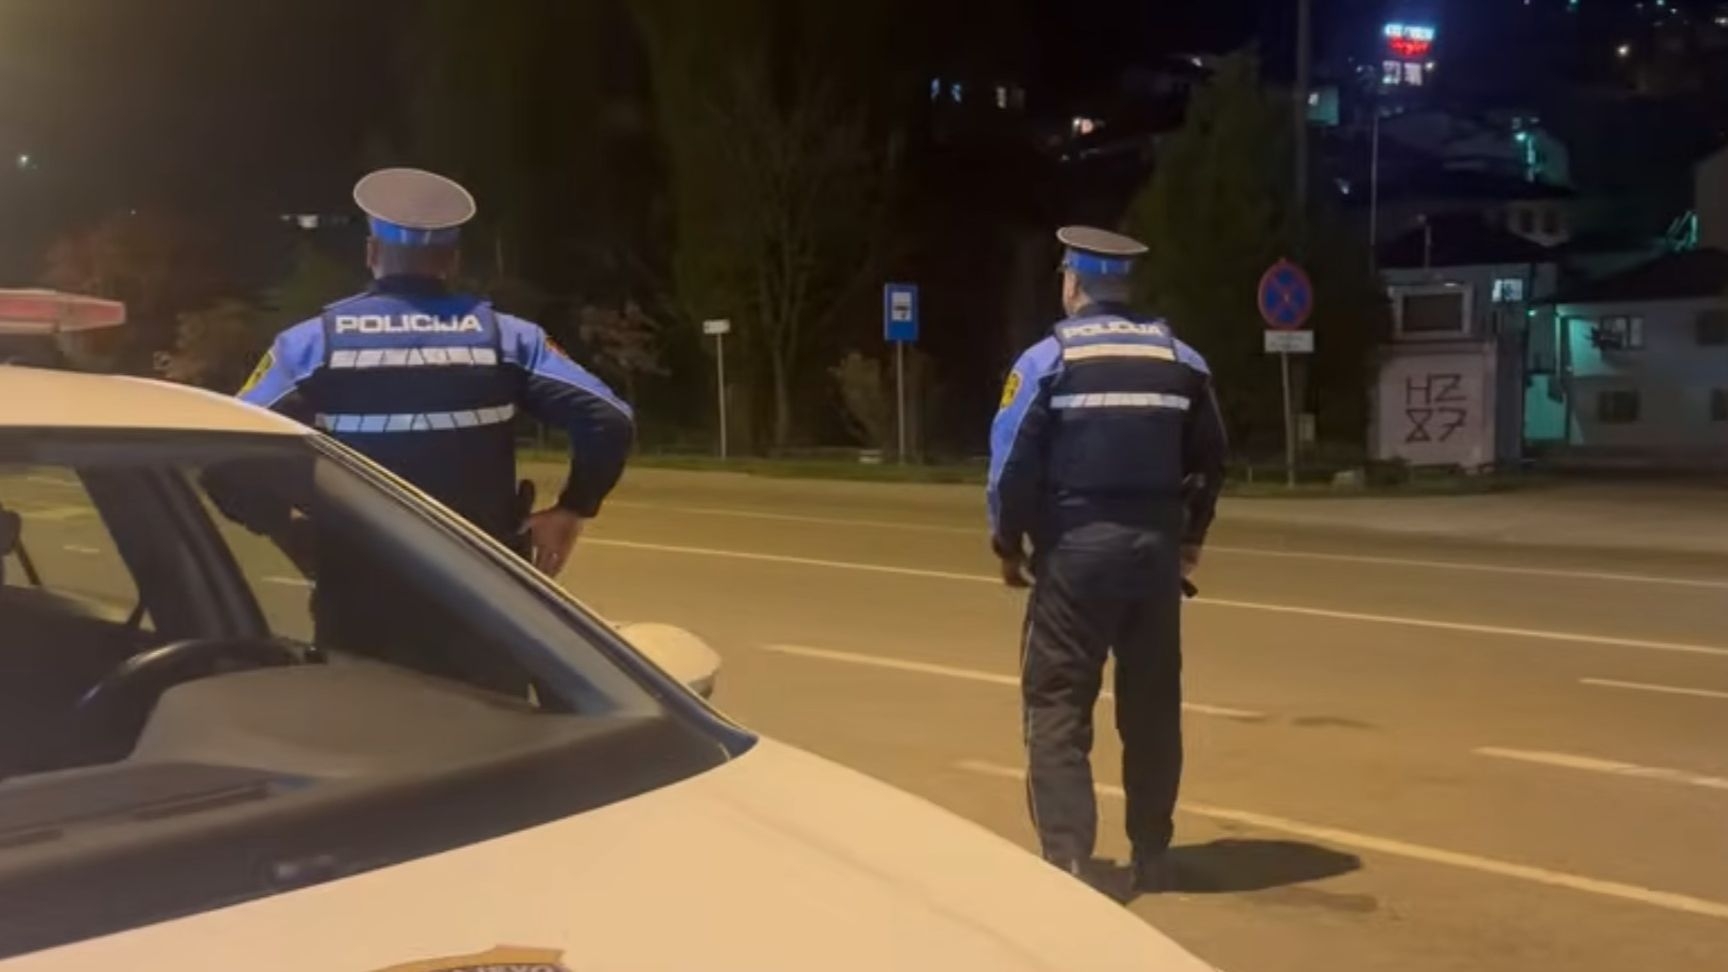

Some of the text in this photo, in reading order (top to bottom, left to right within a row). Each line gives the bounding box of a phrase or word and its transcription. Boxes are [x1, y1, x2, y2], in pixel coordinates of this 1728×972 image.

[335, 314, 483, 334] POLICIJA
[1404, 373, 1467, 406] HZ
[1404, 407, 1467, 443] 87
